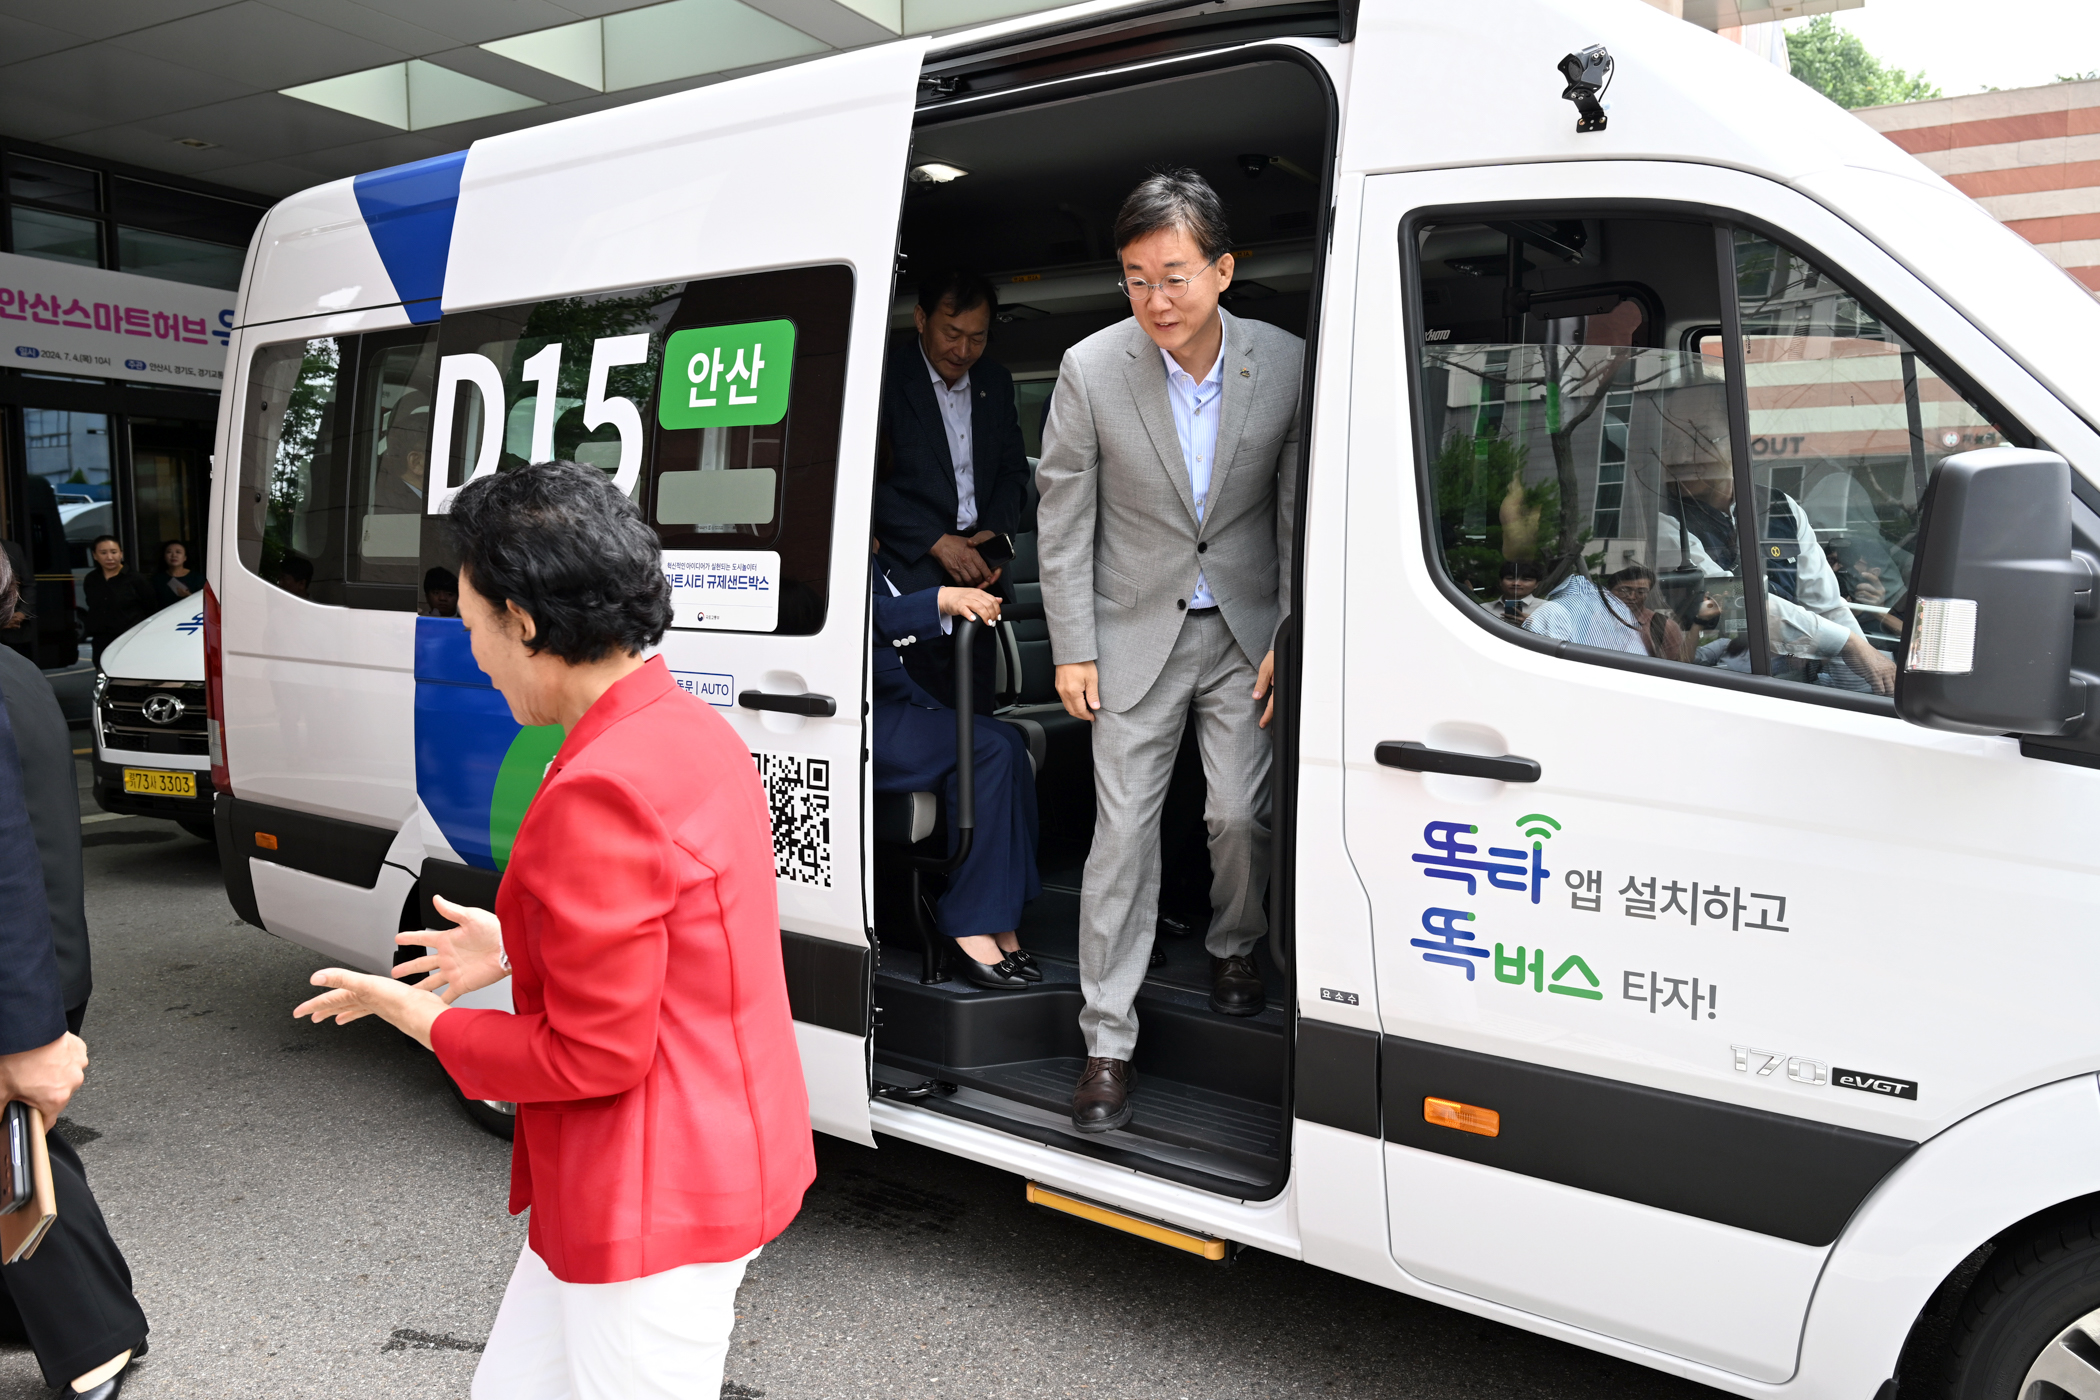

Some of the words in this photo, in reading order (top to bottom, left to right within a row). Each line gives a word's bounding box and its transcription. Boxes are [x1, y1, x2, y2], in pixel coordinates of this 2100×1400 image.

[0, 287, 209, 345] 안산스마트허브
[686, 342, 766, 409] 안산
[427, 333, 650, 515] D15
[1751, 436, 1805, 455] OUT
[706, 575, 769, 591] 규제샌드박스
[700, 682, 729, 696] AUTO
[159, 775, 190, 793] 3303
[1411, 818, 1551, 905] 똑타
[1564, 869, 1603, 913] 앱
[1617, 874, 1790, 933] 설치하고
[1410, 906, 1604, 1002] 똑버스
[1621, 970, 1719, 1021] 타자!
[1730, 1044, 1828, 1087] 170
[1839, 1075, 1910, 1095] eVGT
